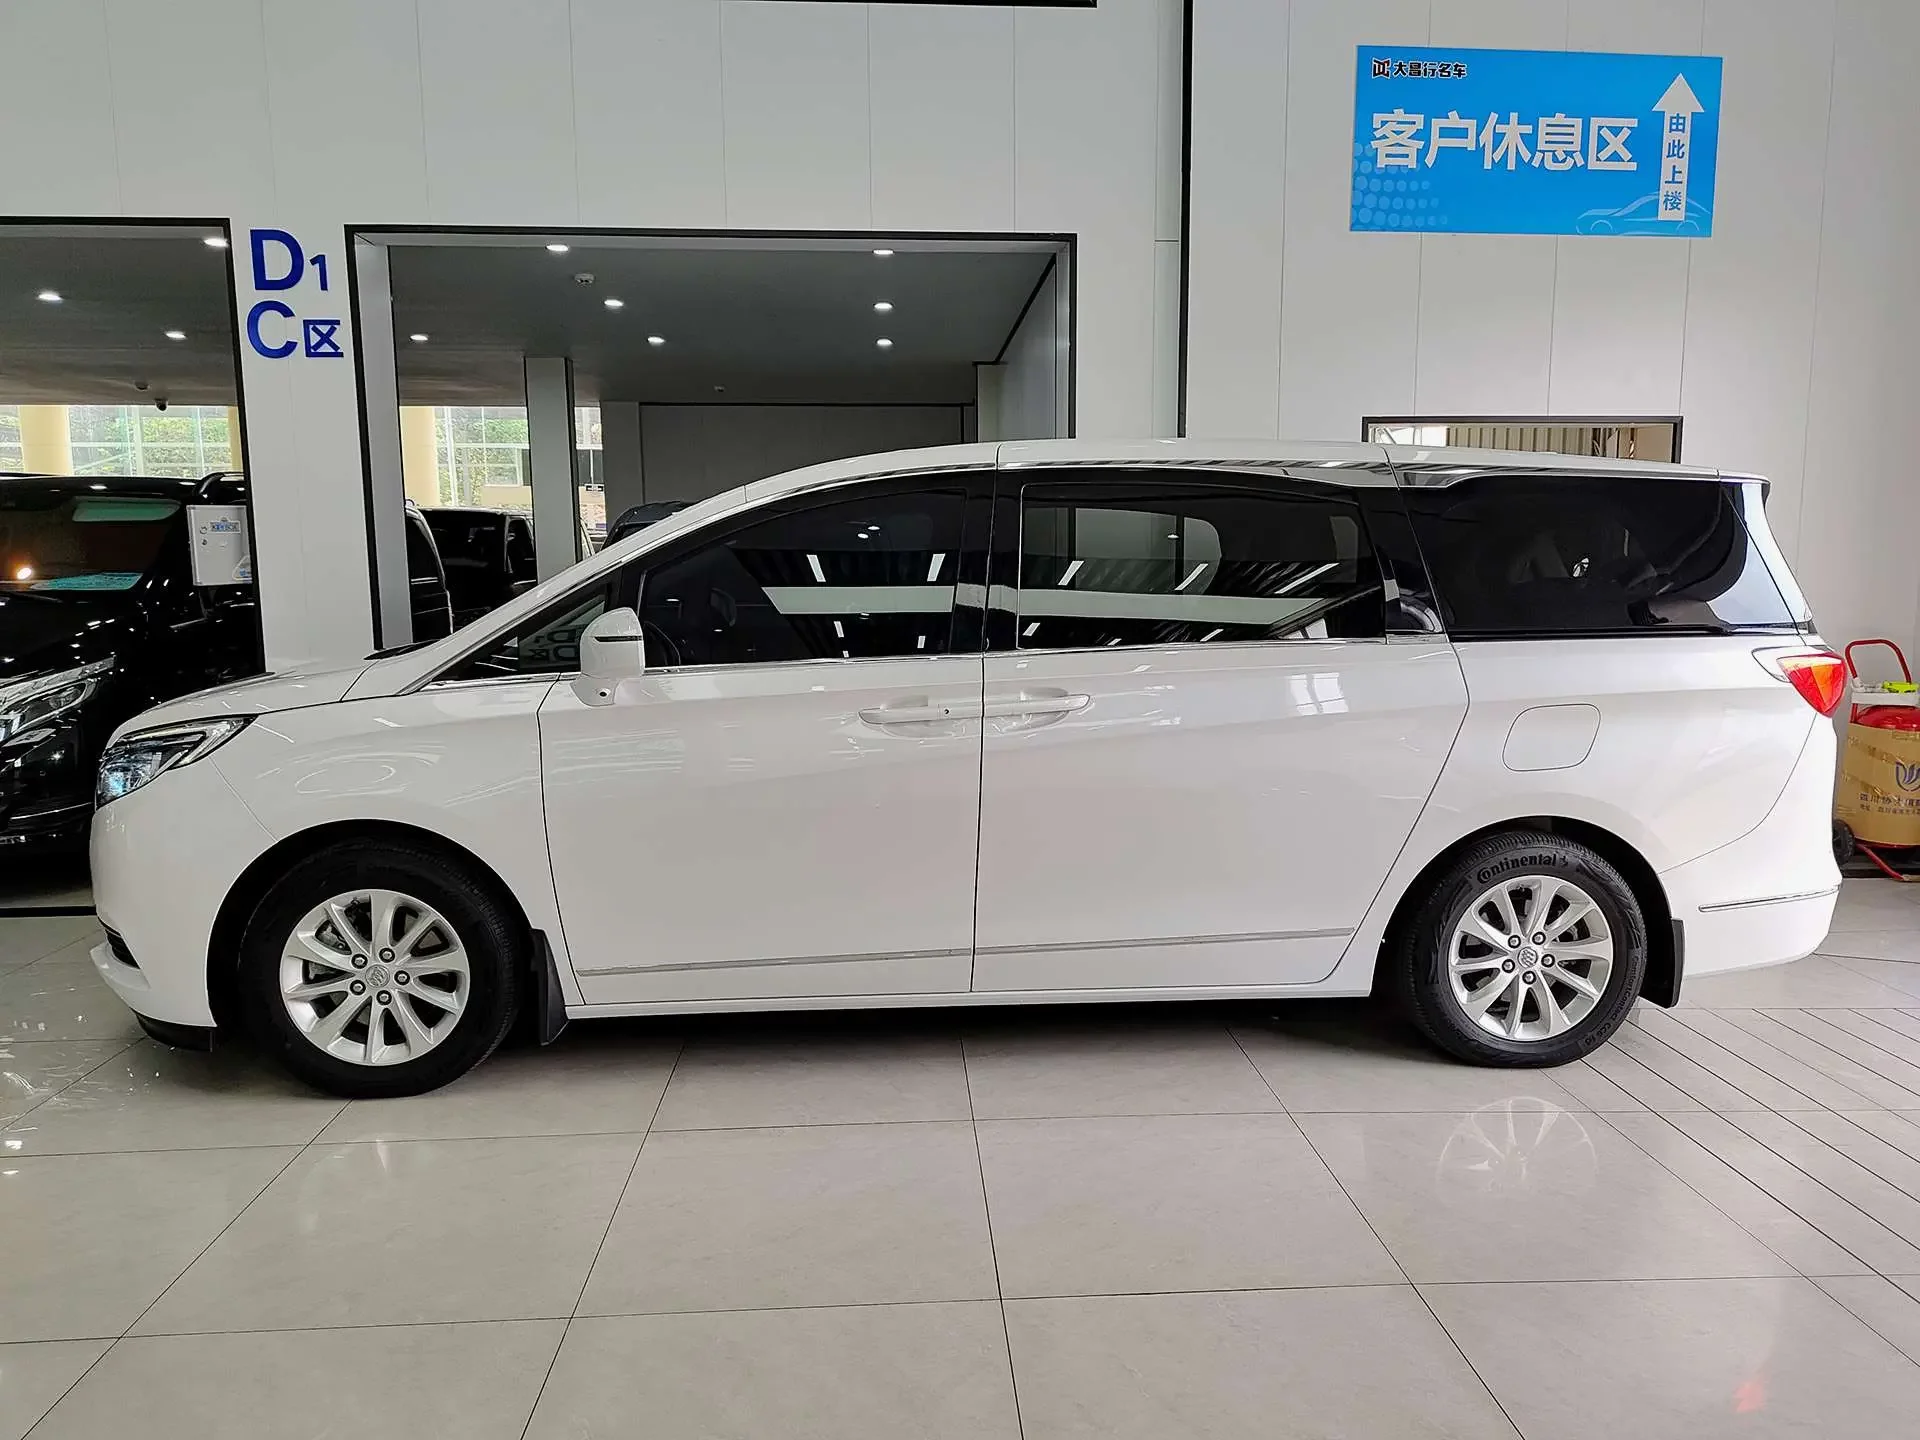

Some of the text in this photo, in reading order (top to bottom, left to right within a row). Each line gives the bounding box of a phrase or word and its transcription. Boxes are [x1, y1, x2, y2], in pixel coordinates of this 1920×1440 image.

[1393, 61, 1467, 79] 大昌行名车
[1371, 108, 1638, 171] 客户休息区
[1663, 113, 1686, 212] 由此上楼
[1477, 853, 1557, 884] Continental
